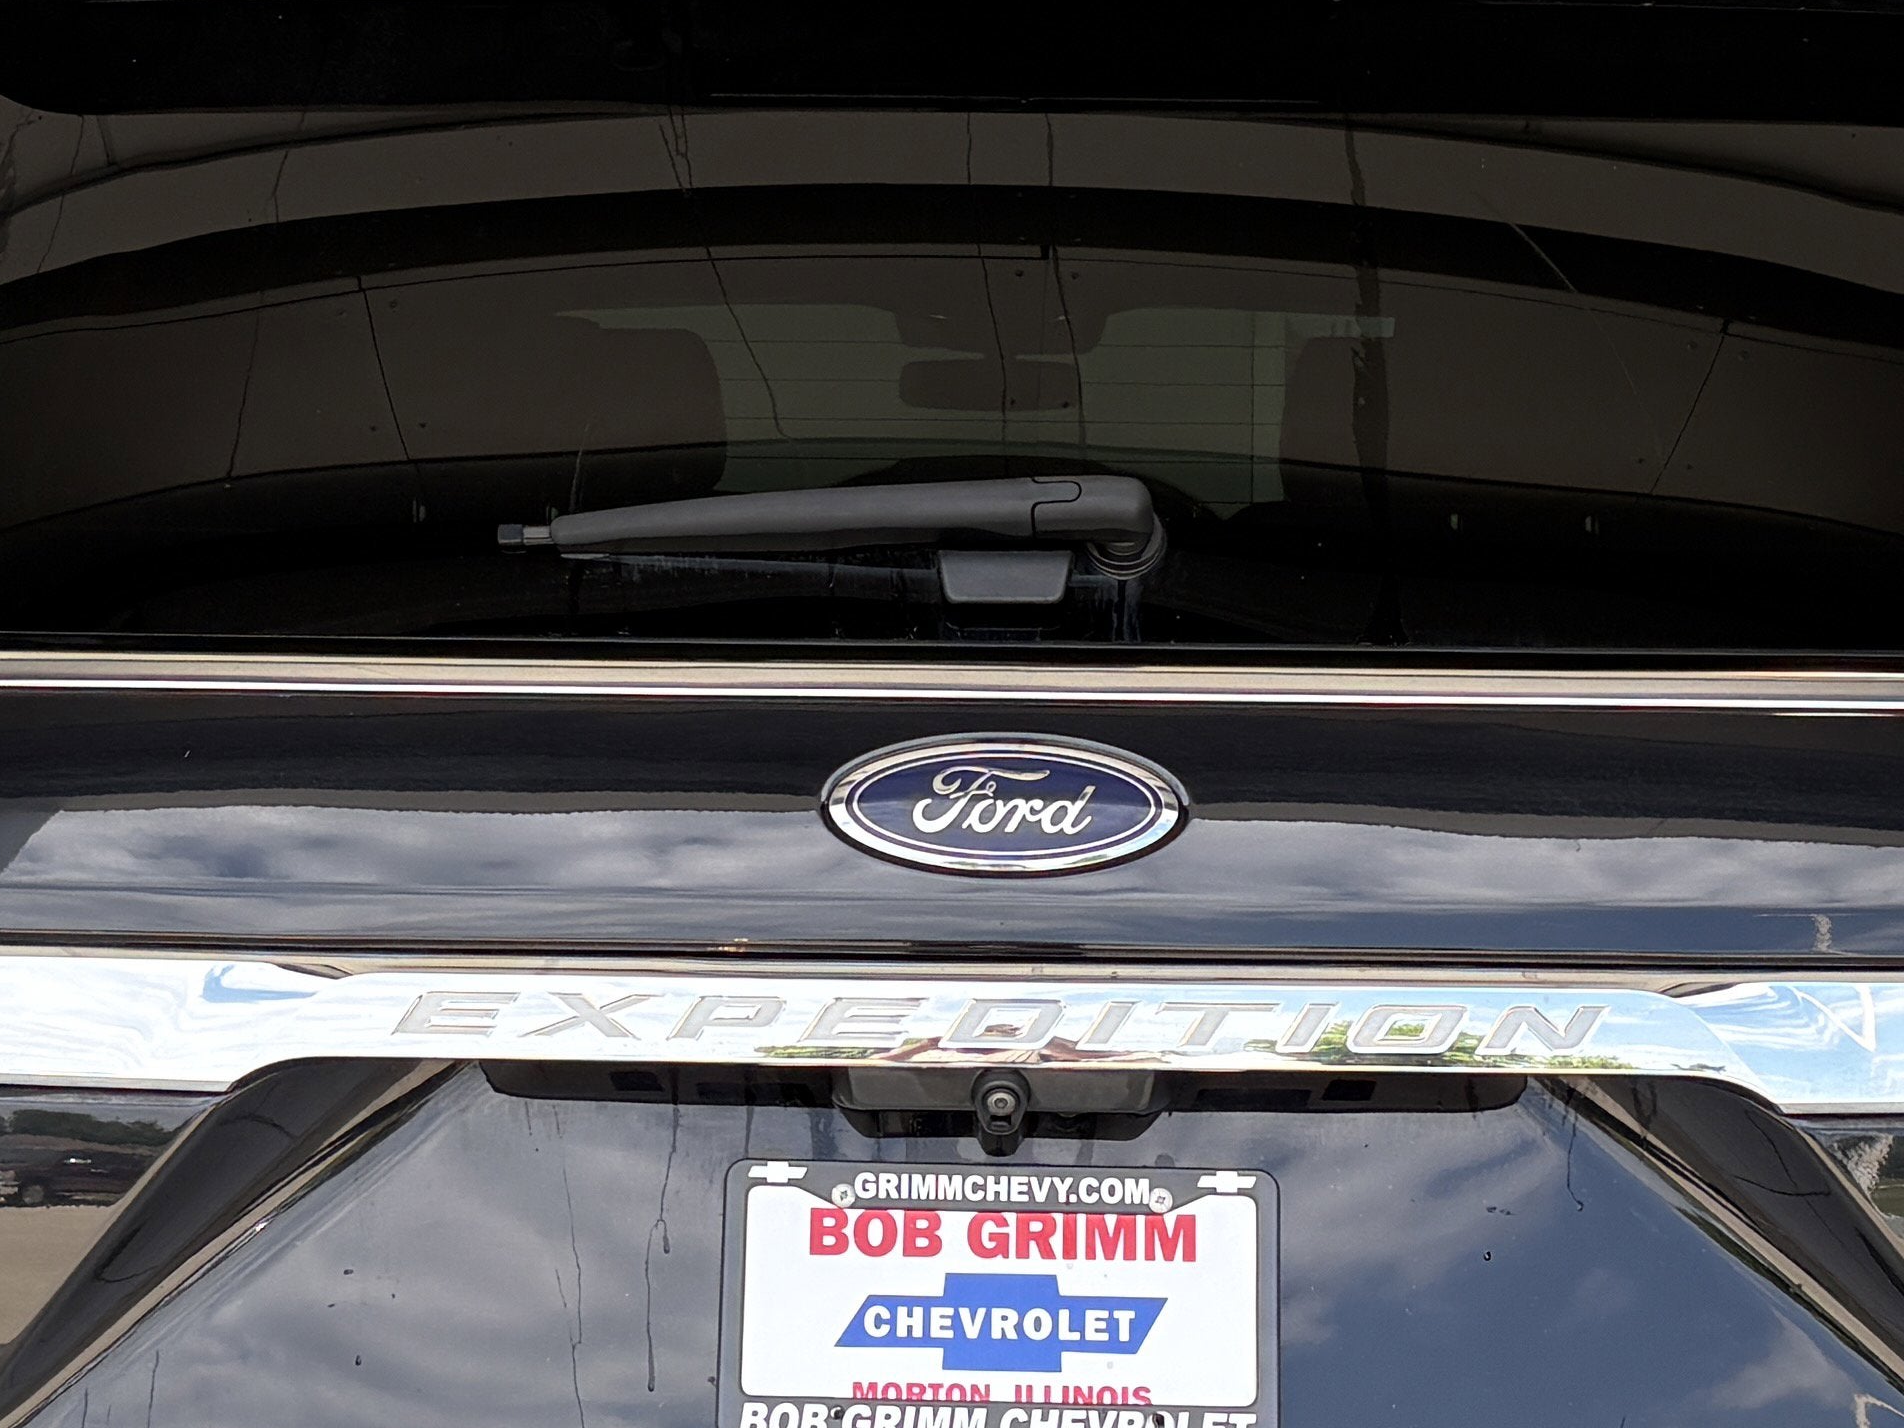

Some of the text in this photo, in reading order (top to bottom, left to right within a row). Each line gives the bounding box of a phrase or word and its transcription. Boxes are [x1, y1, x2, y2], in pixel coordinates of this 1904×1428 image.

[911, 766, 1095, 836] Ford
[390, 990, 1612, 1056] EXPEDITION
[853, 1171, 1150, 1206] GRIMMCHEVY.COM
[808, 1207, 1197, 1262] BOB GRIMM
[862, 1304, 1138, 1343] CHEVROLET
[852, 1382, 991, 1402] MORTON
